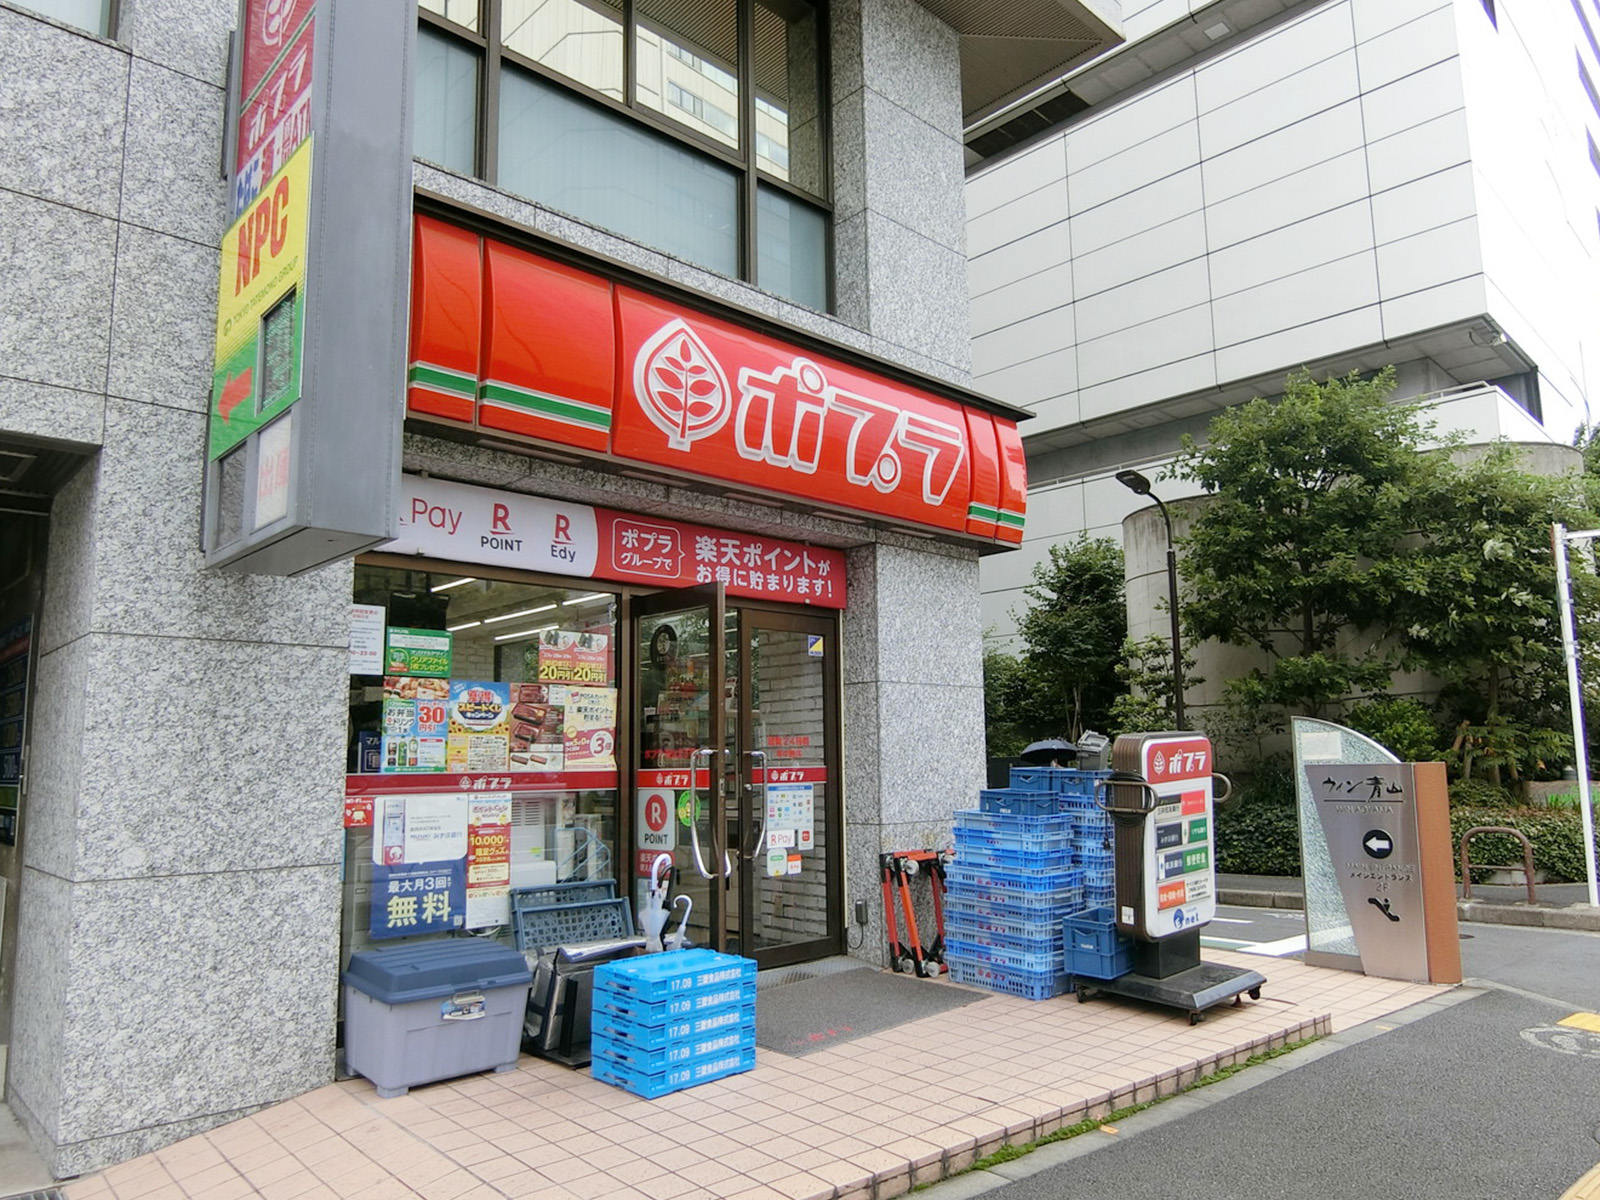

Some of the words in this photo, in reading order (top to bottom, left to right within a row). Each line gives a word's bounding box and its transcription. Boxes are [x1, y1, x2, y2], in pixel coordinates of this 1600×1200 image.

[235, 175, 289, 297] NPC
[734, 357, 965, 506] ポプラ
[412, 497, 462, 535] Pay
[492, 503, 511, 531] R
[554, 513, 571, 541] R
[480, 535, 523, 552] POINT
[621, 529, 673, 554] ポプラ
[550, 544, 576, 562] Edy
[695, 535, 831, 577] 楽天ポイントが
[621, 552, 673, 571] グループで
[410, 656, 448, 664] クリアファイル
[387, 708, 415, 717] お弁当
[418, 706, 445, 723] 30
[458, 703, 502, 713] スピードくじ
[393, 718, 414, 726] ドリンク
[418, 724, 436, 732] 円引
[1168, 749, 1207, 774] ポプラ
[472, 775, 512, 790] ポプラ
[664, 774, 689, 786] ポプラ
[780, 770, 804, 782] ポプラ
[1321, 775, 1403, 803] ウィン青山
[651, 802, 662, 824] R
[1352, 805, 1394, 814] AOYAMA
[644, 833, 668, 845] POINT
[778, 833, 793, 845] Pay
[1186, 852, 1206, 866] 郵便貯金
[1350, 872, 1411, 881] メインエントランス
[1375, 882, 1389, 892] 2F
[387, 890, 452, 928] 無料
[671, 977, 692, 990] 17.09
[670, 1000, 691, 1013] 17.09
[668, 1024, 690, 1038] 17.09
[668, 1047, 690, 1061] 17.09
[669, 1070, 691, 1084] 17.09
